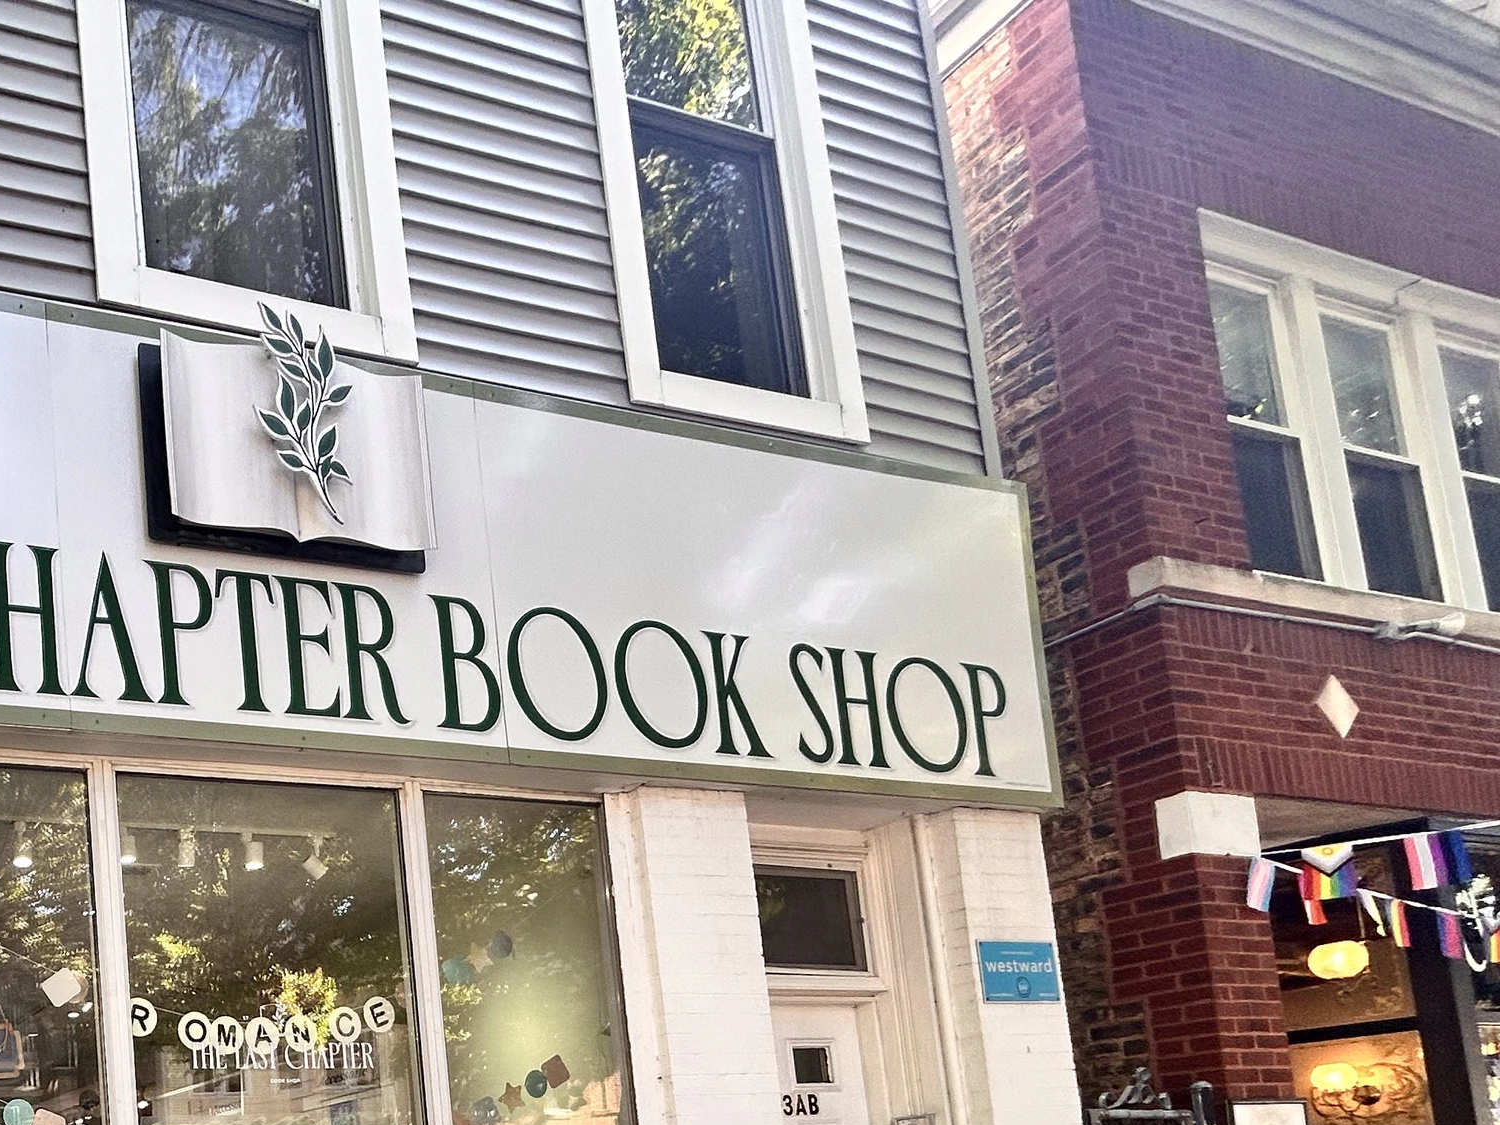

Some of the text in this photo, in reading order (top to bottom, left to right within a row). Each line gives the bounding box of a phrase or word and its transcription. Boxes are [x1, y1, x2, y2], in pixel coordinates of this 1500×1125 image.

[427, 594, 774, 758] BOOK
[789, 643, 1005, 777] SHOP
[985, 957, 1053, 973] westward
[191, 1042, 375, 1070] THE LAST CHAPTER
[782, 1093, 820, 1116] 3AB
